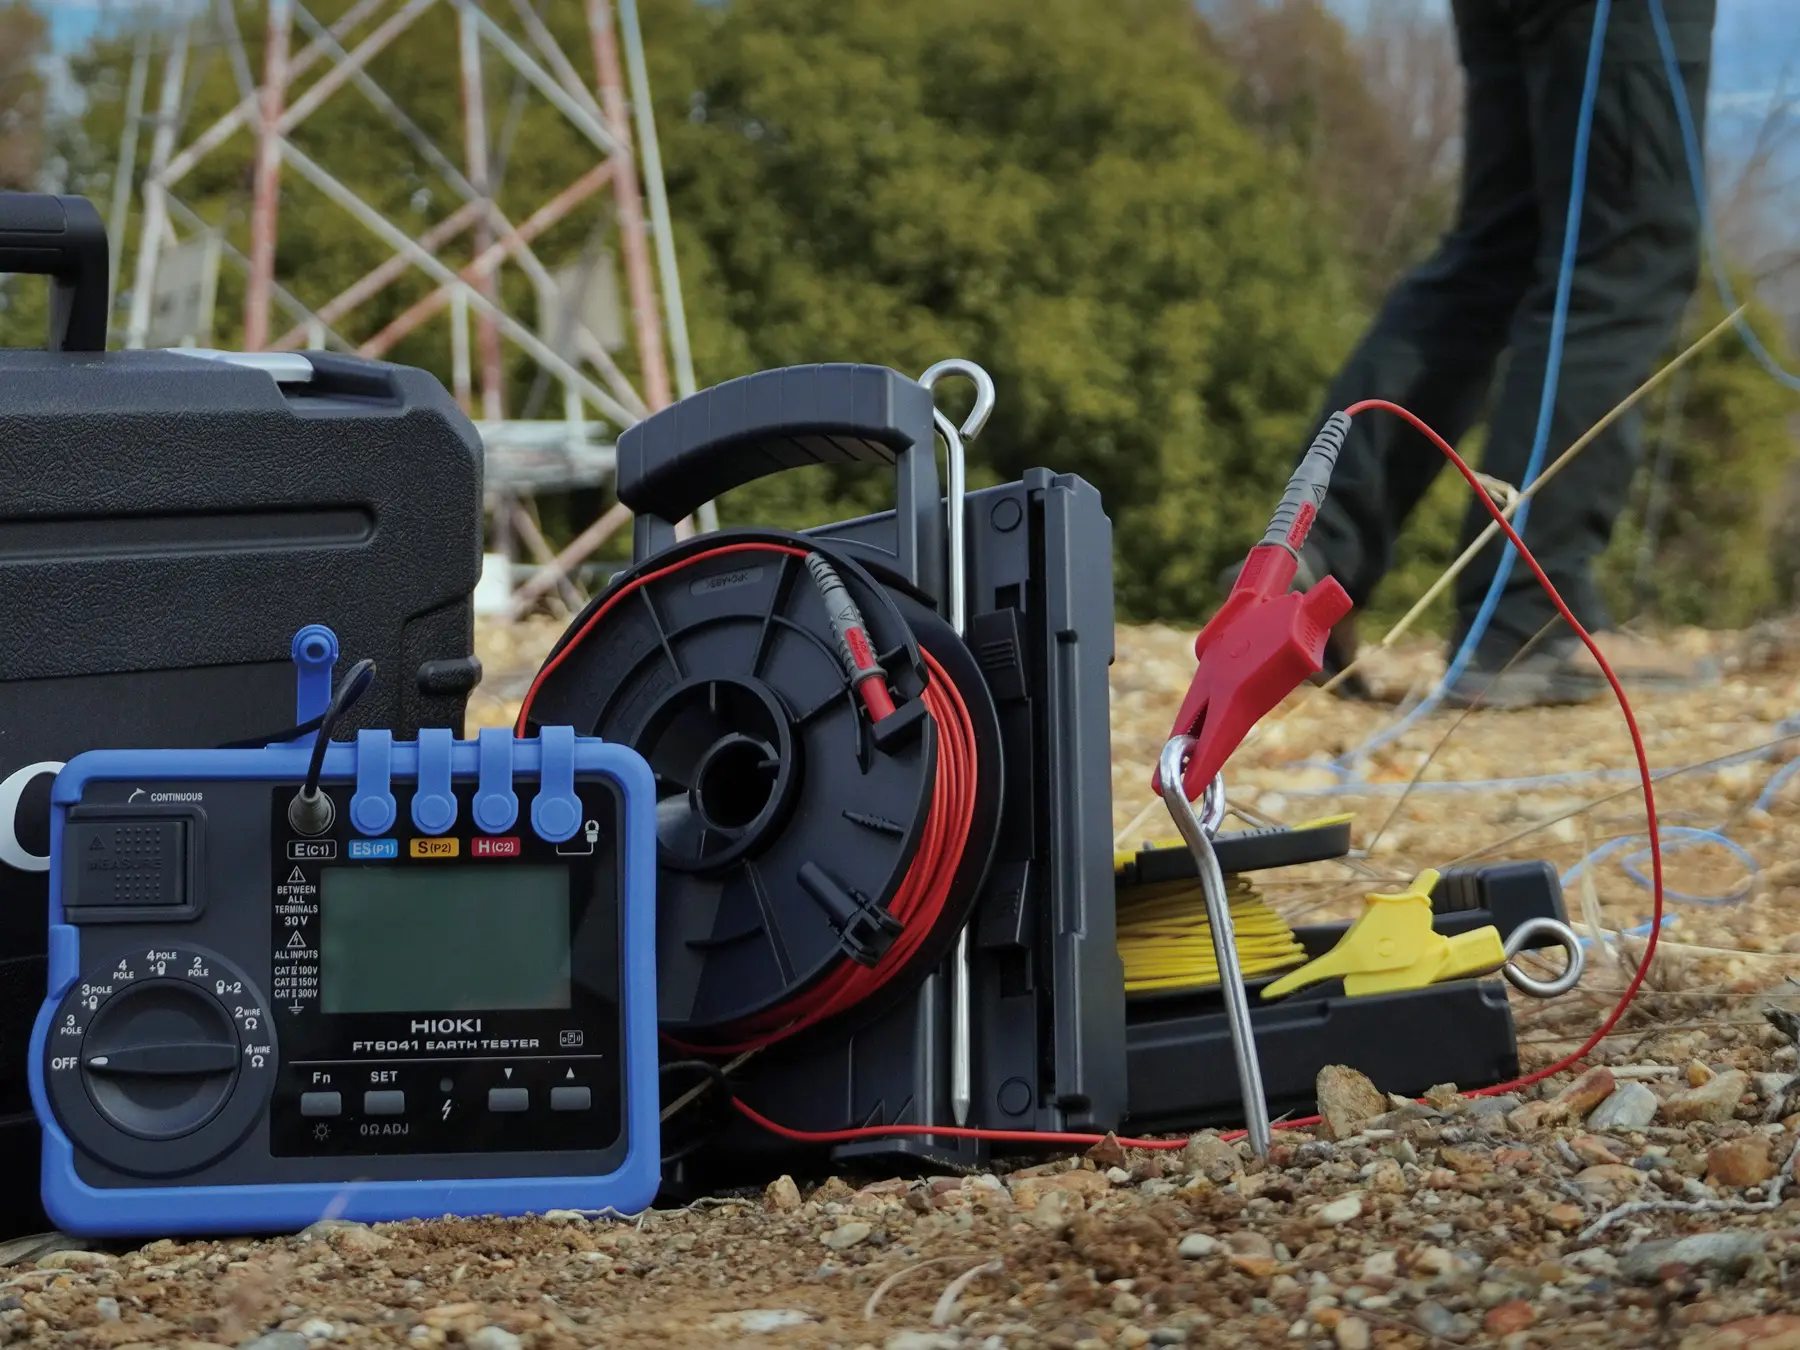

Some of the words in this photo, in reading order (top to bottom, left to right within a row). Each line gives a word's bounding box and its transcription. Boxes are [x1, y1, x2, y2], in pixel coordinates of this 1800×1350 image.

[151, 793, 203, 802] CONTINUOUS
[277, 885, 316, 895] BETWEEN
[288, 894, 305, 904] ALL
[274, 904, 319, 914] TERMINALS
[275, 950, 289, 959] ALL
[290, 950, 319, 959] INPUTS
[113, 971, 134, 980] POLE
[188, 968, 208, 977] POLE
[275, 967, 290, 976] CAT
[298, 966, 318, 976] 100V
[275, 977, 290, 987] CAT
[298, 977, 318, 987] 150V
[275, 989, 290, 998] CAT
[298, 988, 318, 998] 300V
[61, 1026, 82, 1034] POLE
[412, 1018, 481, 1033] HIOKI
[353, 1041, 419, 1051] FT6041
[426, 1039, 477, 1050] EARTH
[481, 1038, 539, 1049] TESTER
[52, 1057, 77, 1069] OFF
[313, 1072, 331, 1083] Fn
[371, 1071, 398, 1083] SET
[383, 1123, 409, 1135] ADJ
